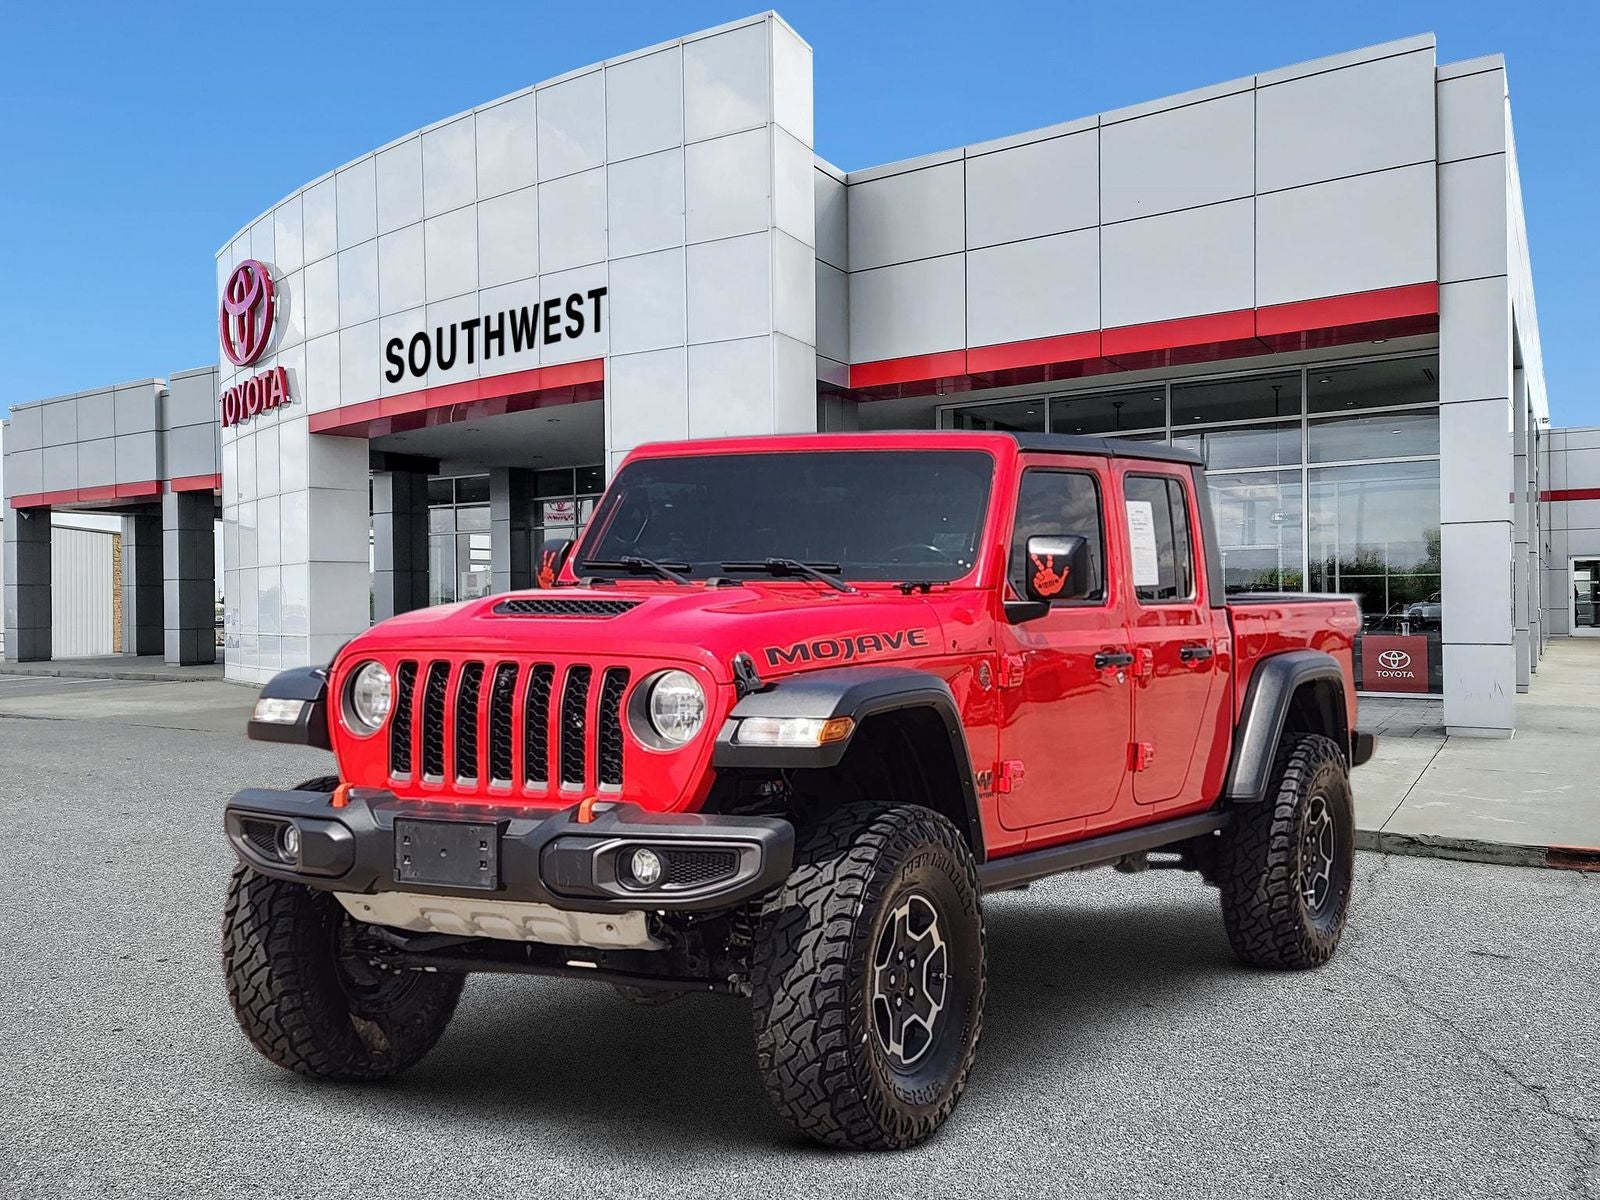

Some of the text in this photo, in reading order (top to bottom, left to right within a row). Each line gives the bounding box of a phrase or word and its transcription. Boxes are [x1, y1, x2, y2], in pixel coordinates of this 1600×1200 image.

[385, 286, 608, 384] SOUTHWEST
[218, 366, 291, 427] TOYOTA
[764, 628, 930, 667] MOJAVE
[1375, 670, 1415, 678] TOYOTA
